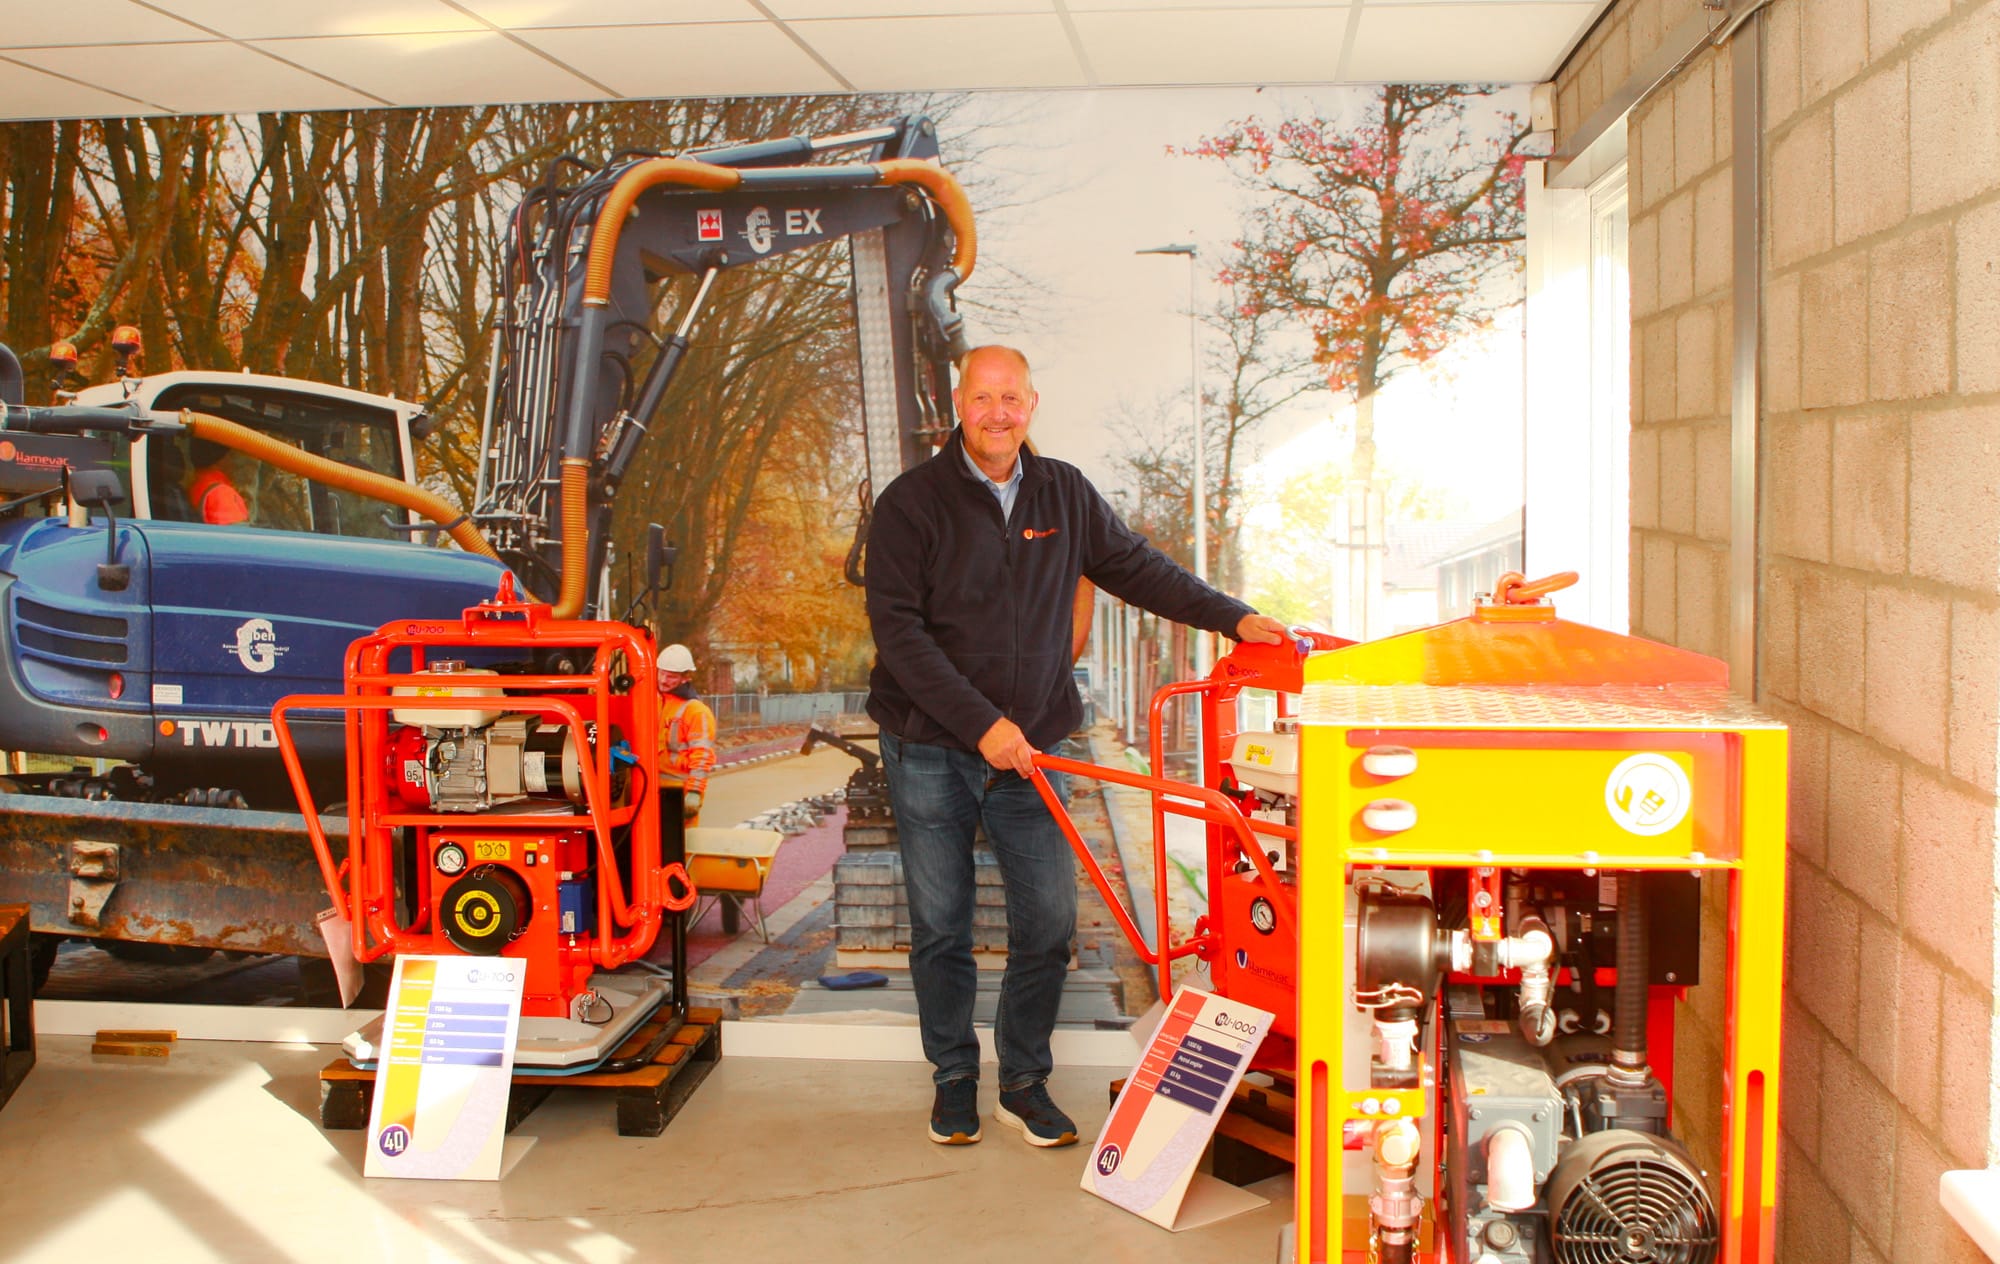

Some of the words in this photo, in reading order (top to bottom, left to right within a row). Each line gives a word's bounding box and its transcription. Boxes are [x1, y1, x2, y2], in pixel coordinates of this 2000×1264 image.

[786, 209, 823, 235] EX
[178, 720, 280, 748] TW110
[383, 1130, 404, 1152] 40
[1100, 1150, 1118, 1172] 40
